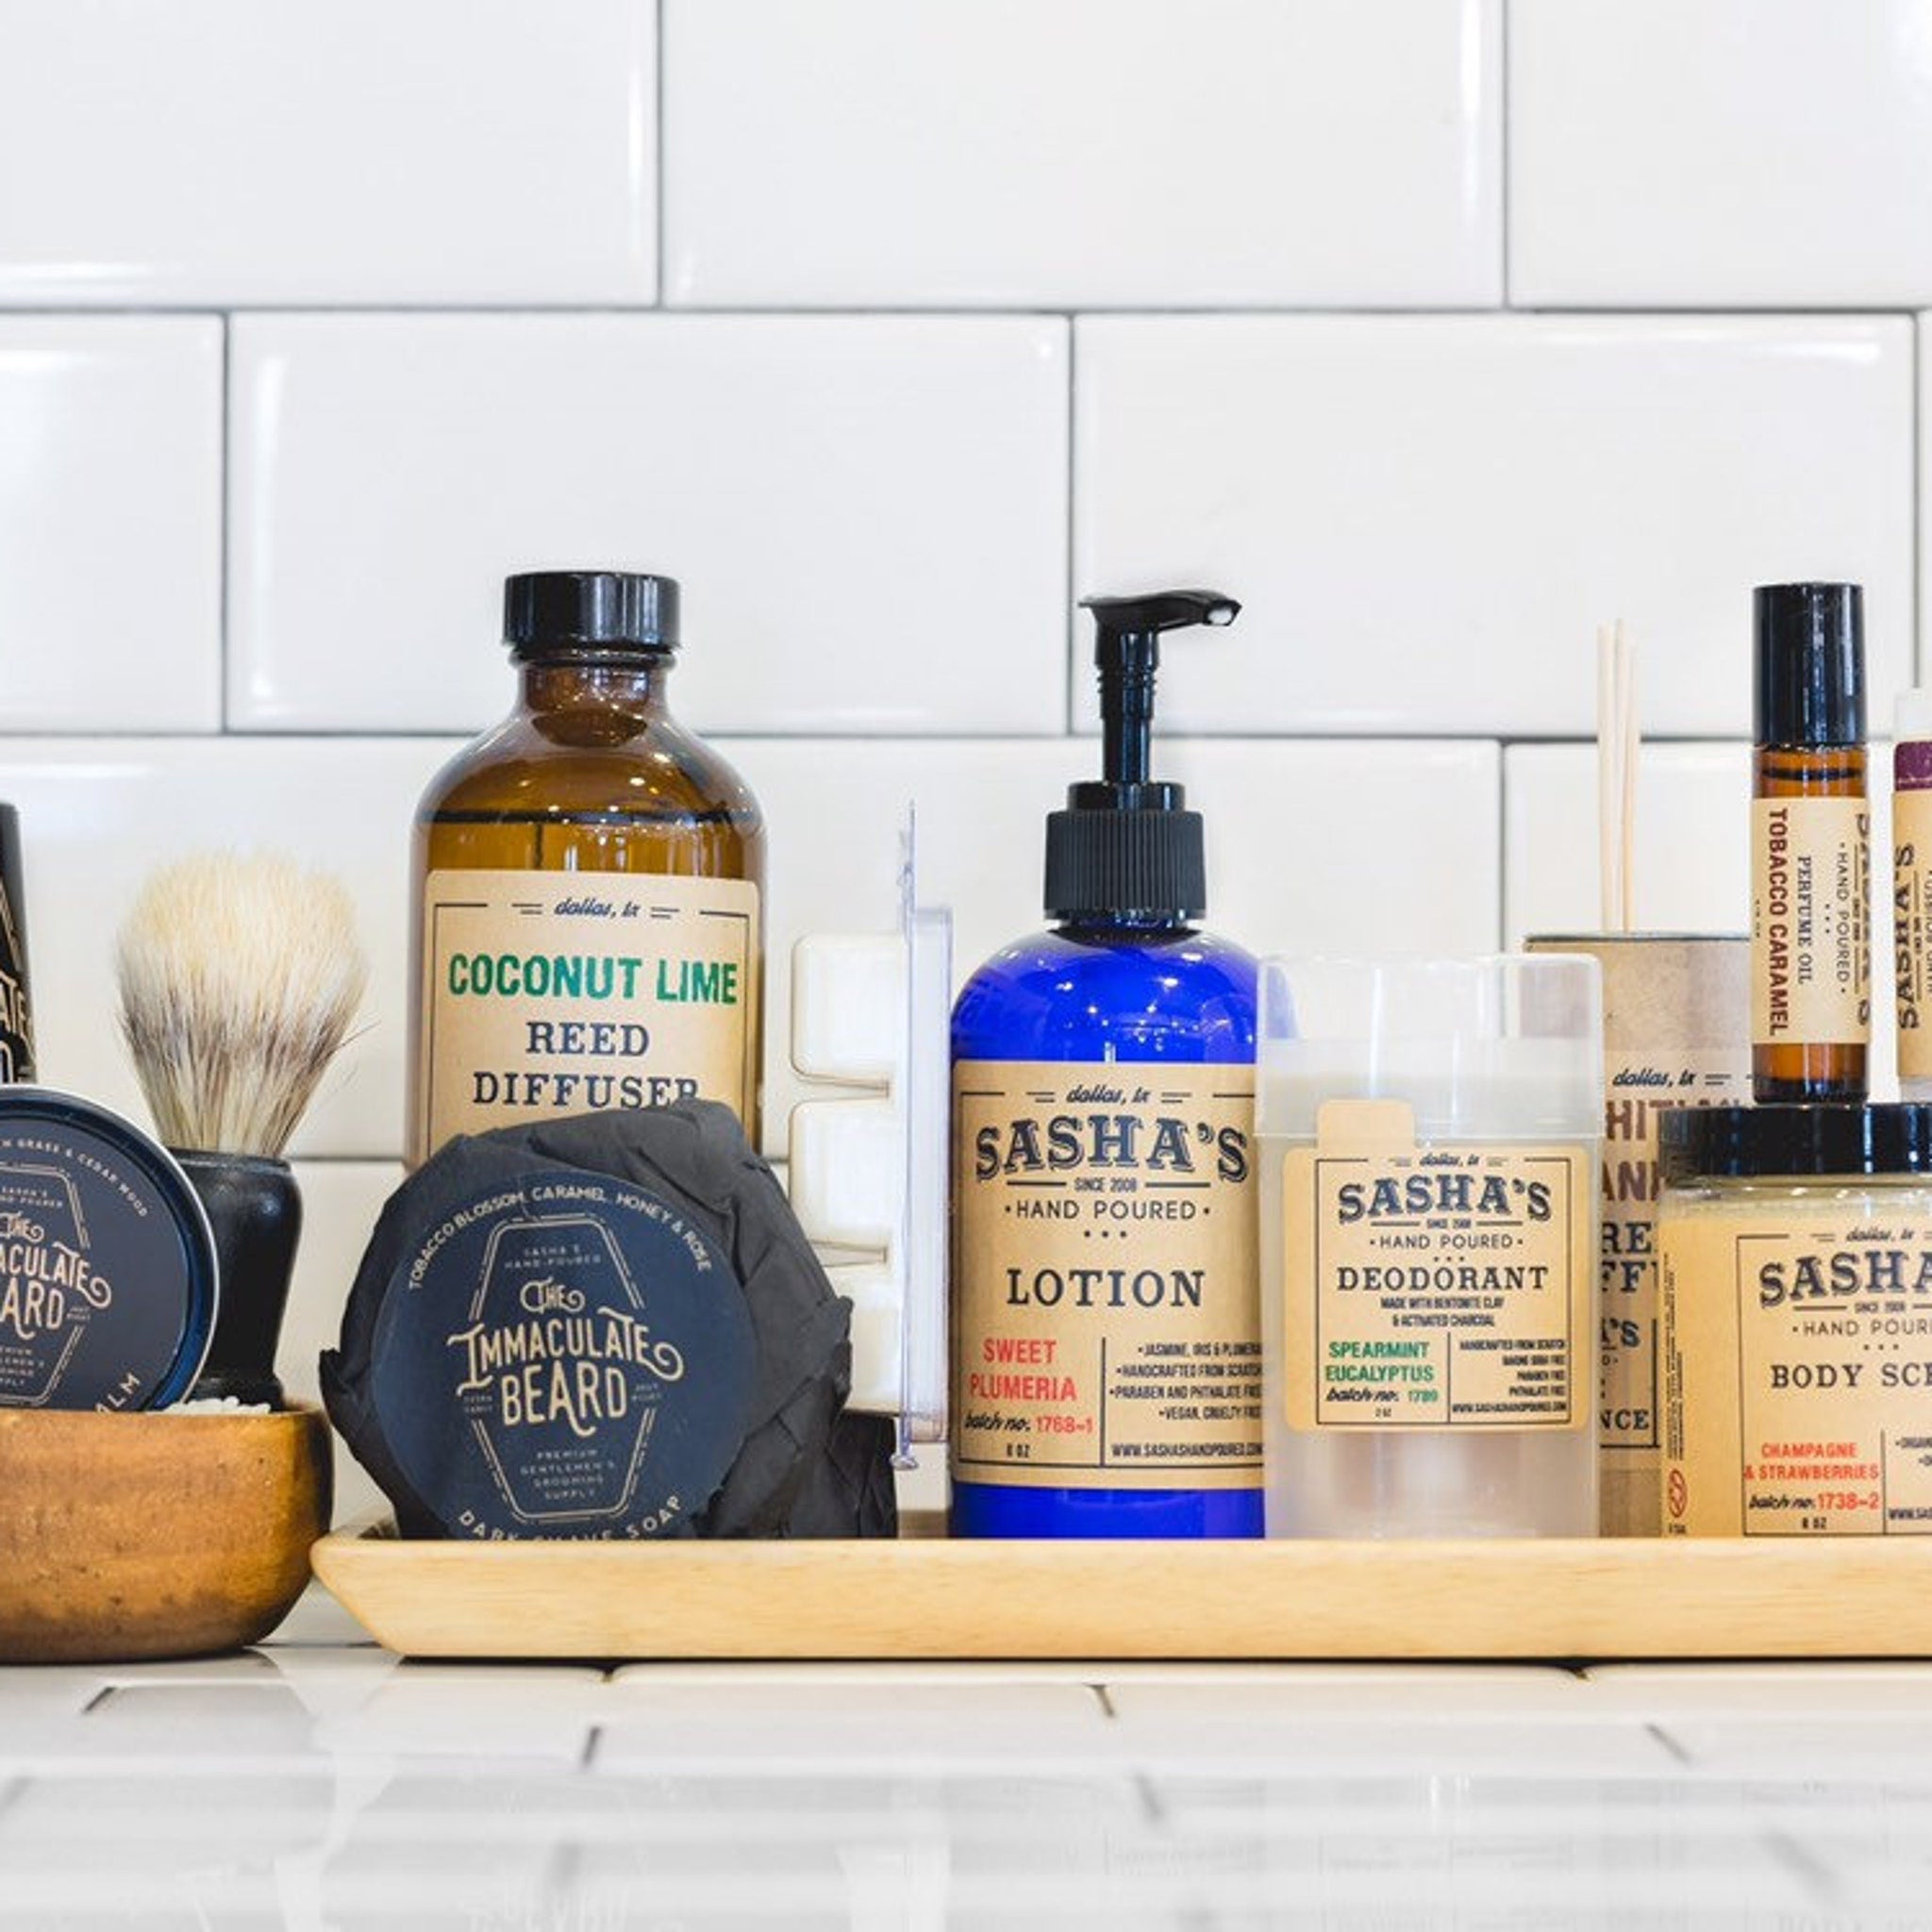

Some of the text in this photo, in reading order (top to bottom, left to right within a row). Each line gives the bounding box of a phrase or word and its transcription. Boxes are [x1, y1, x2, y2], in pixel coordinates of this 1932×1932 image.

[554, 897, 641, 918] dallas, tx
[1837, 853, 1849, 983] HAND POURED
[1769, 808, 1789, 1036] TOBACCO CARAMEL
[1797, 856, 1811, 984] PERFUME OIL
[448, 953, 738, 1004] COCONUT LIME
[525, 1022, 650, 1057] REED
[1066, 1084, 1150, 1105] dallas, tx
[975, 1114, 1250, 1184] SASHA'S
[1074, 1178, 1105, 1192] SINCE
[118, 1182, 148, 1217] WOOD
[1338, 1174, 1552, 1225] SASHA'S
[1017, 1200, 1196, 1221] HAND POURED
[408, 1224, 456, 1290] TOBACCO
[615, 1192, 673, 1223] HONEY
[671, 1220, 683, 1233] &
[682, 1230, 712, 1273] ROSE
[1380, 1234, 1513, 1250] HAND POURED
[1007, 1269, 1206, 1307] LOTION
[1337, 1267, 1549, 1291] DEODORANT
[520, 1275, 585, 1314] THE
[1380, 1296, 1405, 1309] MADE
[1408, 1296, 1433, 1309] WITH
[1483, 1296, 1505, 1309] CLAY
[1401, 1313, 1448, 1327] ACTIVATED
[1450, 1313, 1495, 1327] CHARCOAL
[1804, 1319, 1932, 1337] HAND POUR
[447, 1307, 684, 1396] IMMACULATE
[983, 1337, 1057, 1365] SWEET
[1328, 1341, 1430, 1358] SPEARMINT
[1325, 1365, 1435, 1382] EUCALYPTUS
[1771, 1364, 1863, 1389] BODY
[501, 1360, 626, 1437] BEARD
[970, 1374, 1077, 1402] PLUMERIA
[1115, 1385, 1165, 1399] PARABEN
[1167, 1385, 1188, 1398] AND
[1325, 1387, 1373, 1403] batch
[964, 1410, 1003, 1431] batch
[536, 1448, 597, 1460] PREMIUM
[1761, 1442, 1857, 1458] CHAMPAGNE
[520, 1461, 615, 1475] GENTLEMEN'S
[1744, 1463, 1879, 1480] & STRAWBERRIES
[532, 1474, 604, 1488] GROOMING
[544, 1489, 594, 1500] SUPPLY
[1749, 1494, 1790, 1509] batch
[625, 1495, 681, 1539] SOAP
